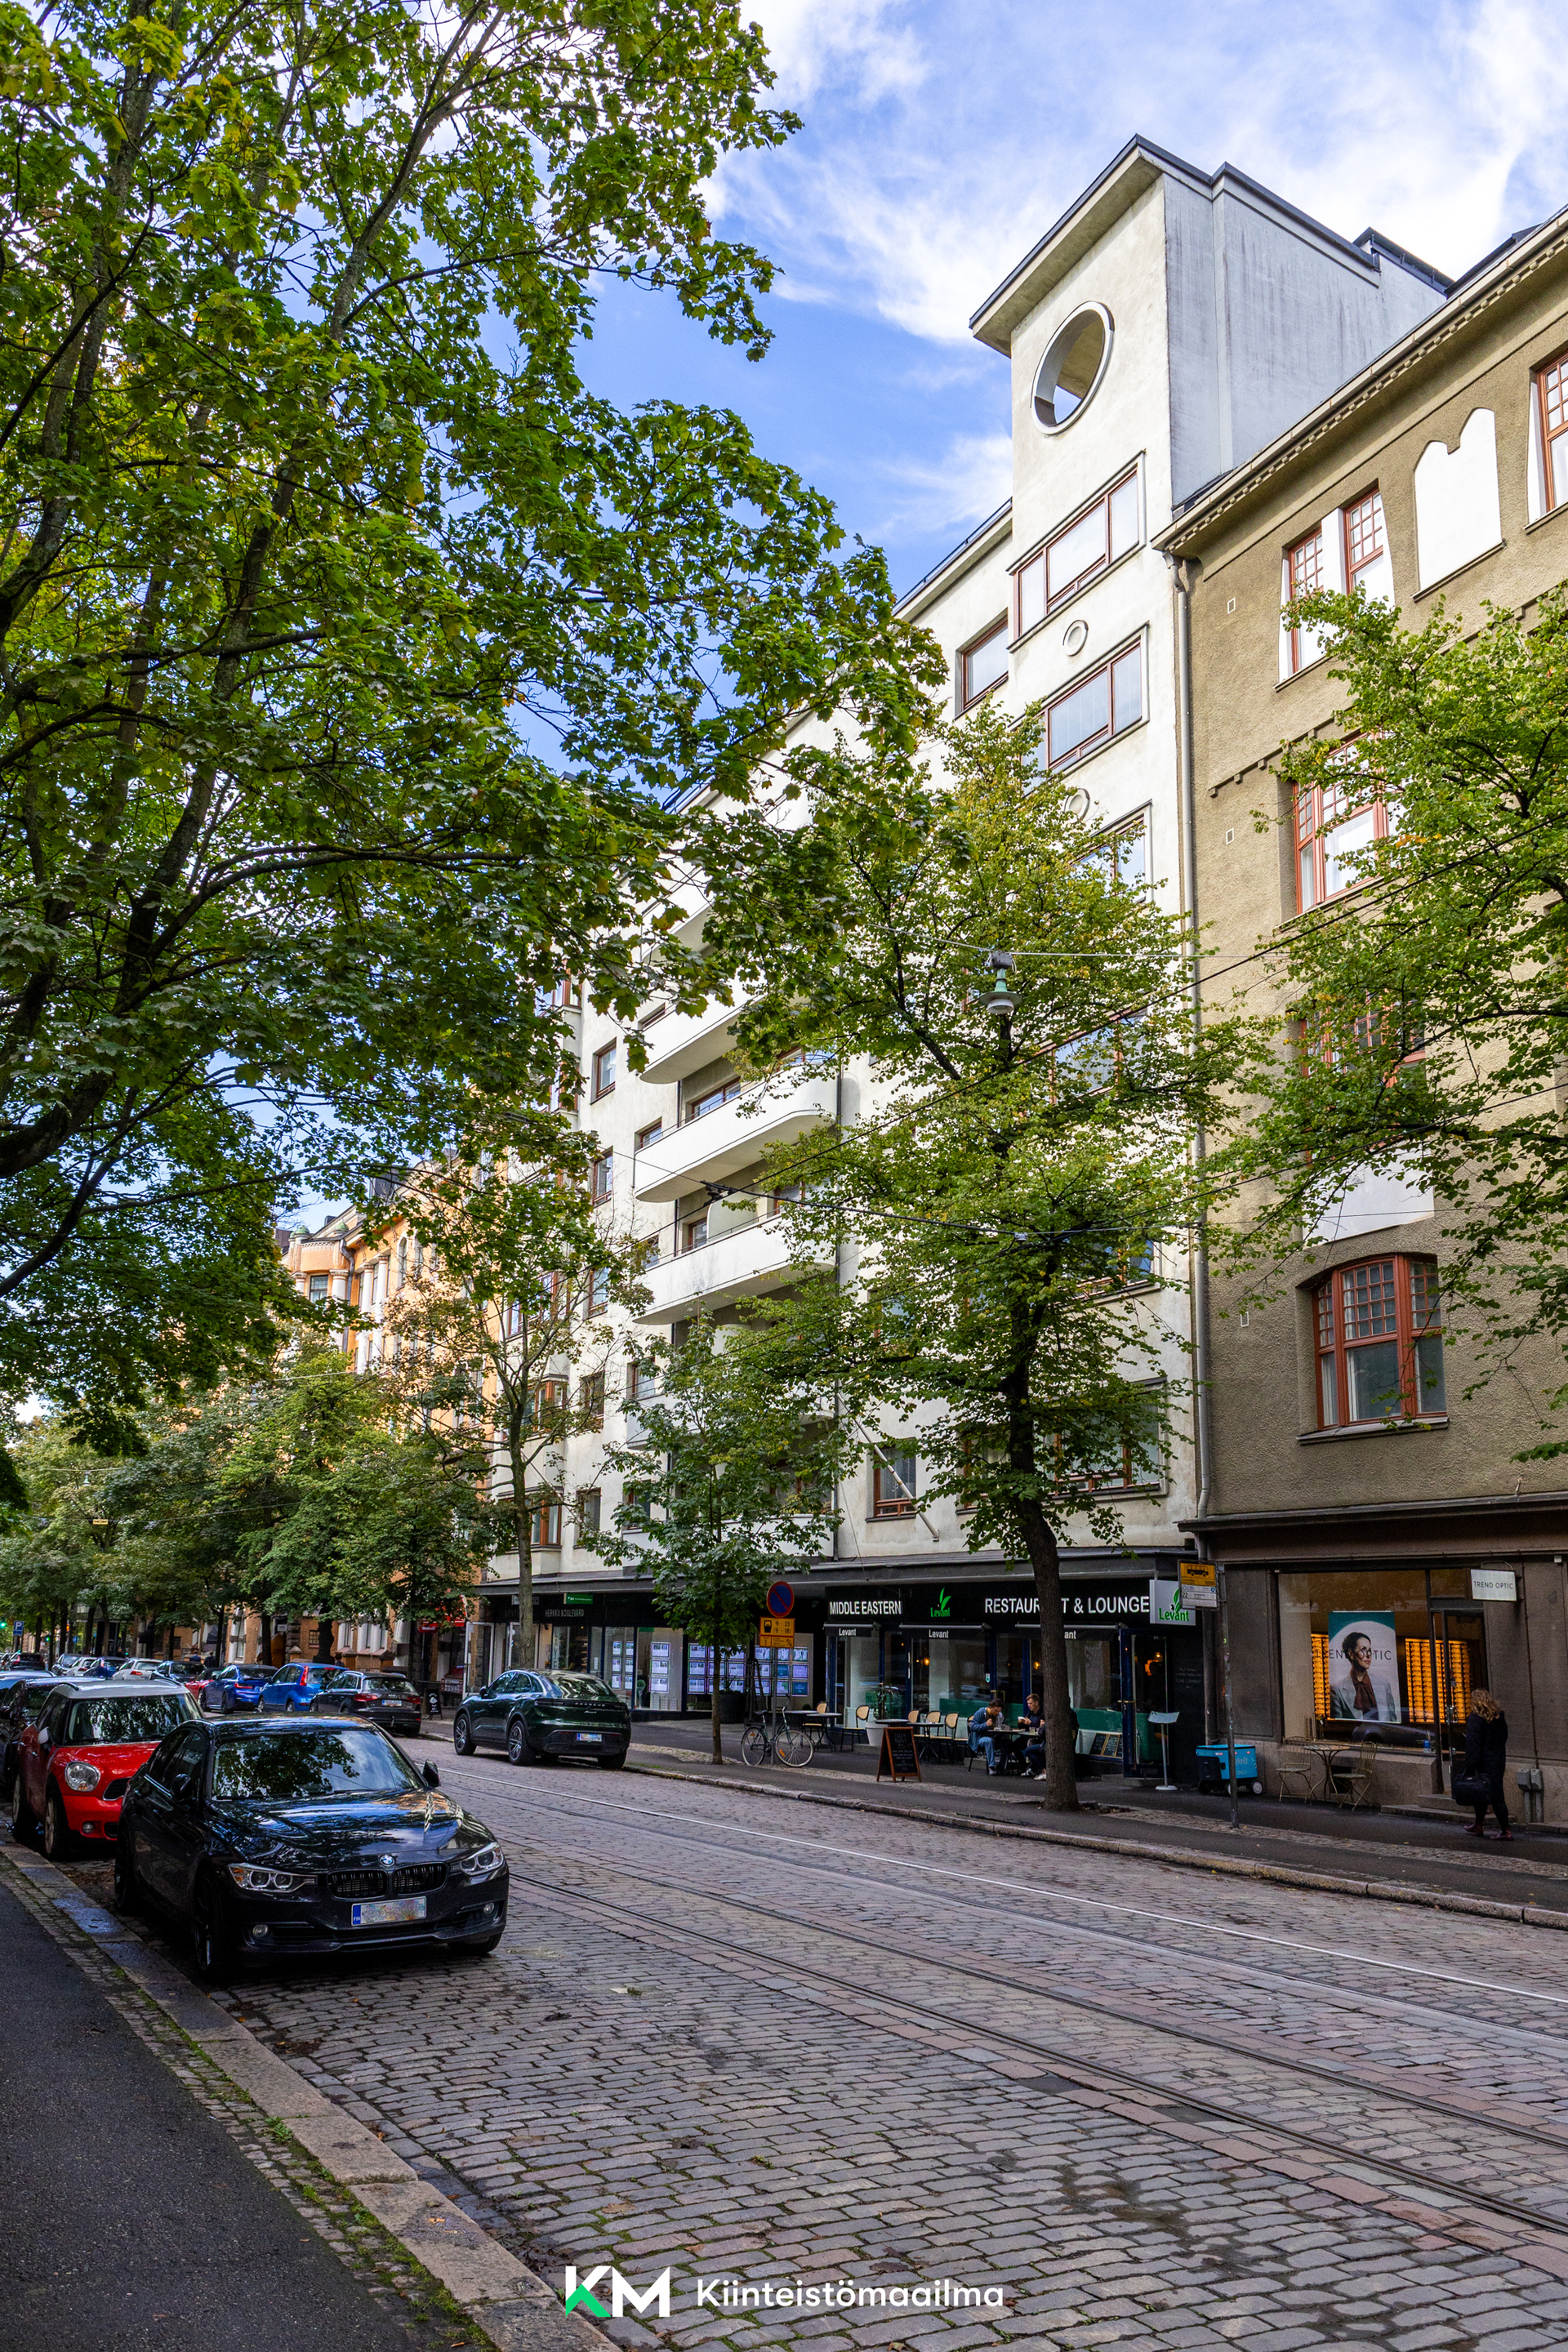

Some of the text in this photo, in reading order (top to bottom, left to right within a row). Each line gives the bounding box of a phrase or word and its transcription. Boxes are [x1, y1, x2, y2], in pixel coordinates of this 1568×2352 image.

[1495, 1582, 1513, 1590] OPTIC
[830, 1600, 902, 1615] MIDDLE EASTERN
[984, 1596, 1150, 1614] RESTAURT & LOUNGE
[930, 1606, 951, 1617] Levant
[1158, 1607, 1190, 1622] Levant
[15, 1621, 22, 1630] P
[838, 1628, 857, 1636] Levant
[929, 1629, 949, 1638] Levant
